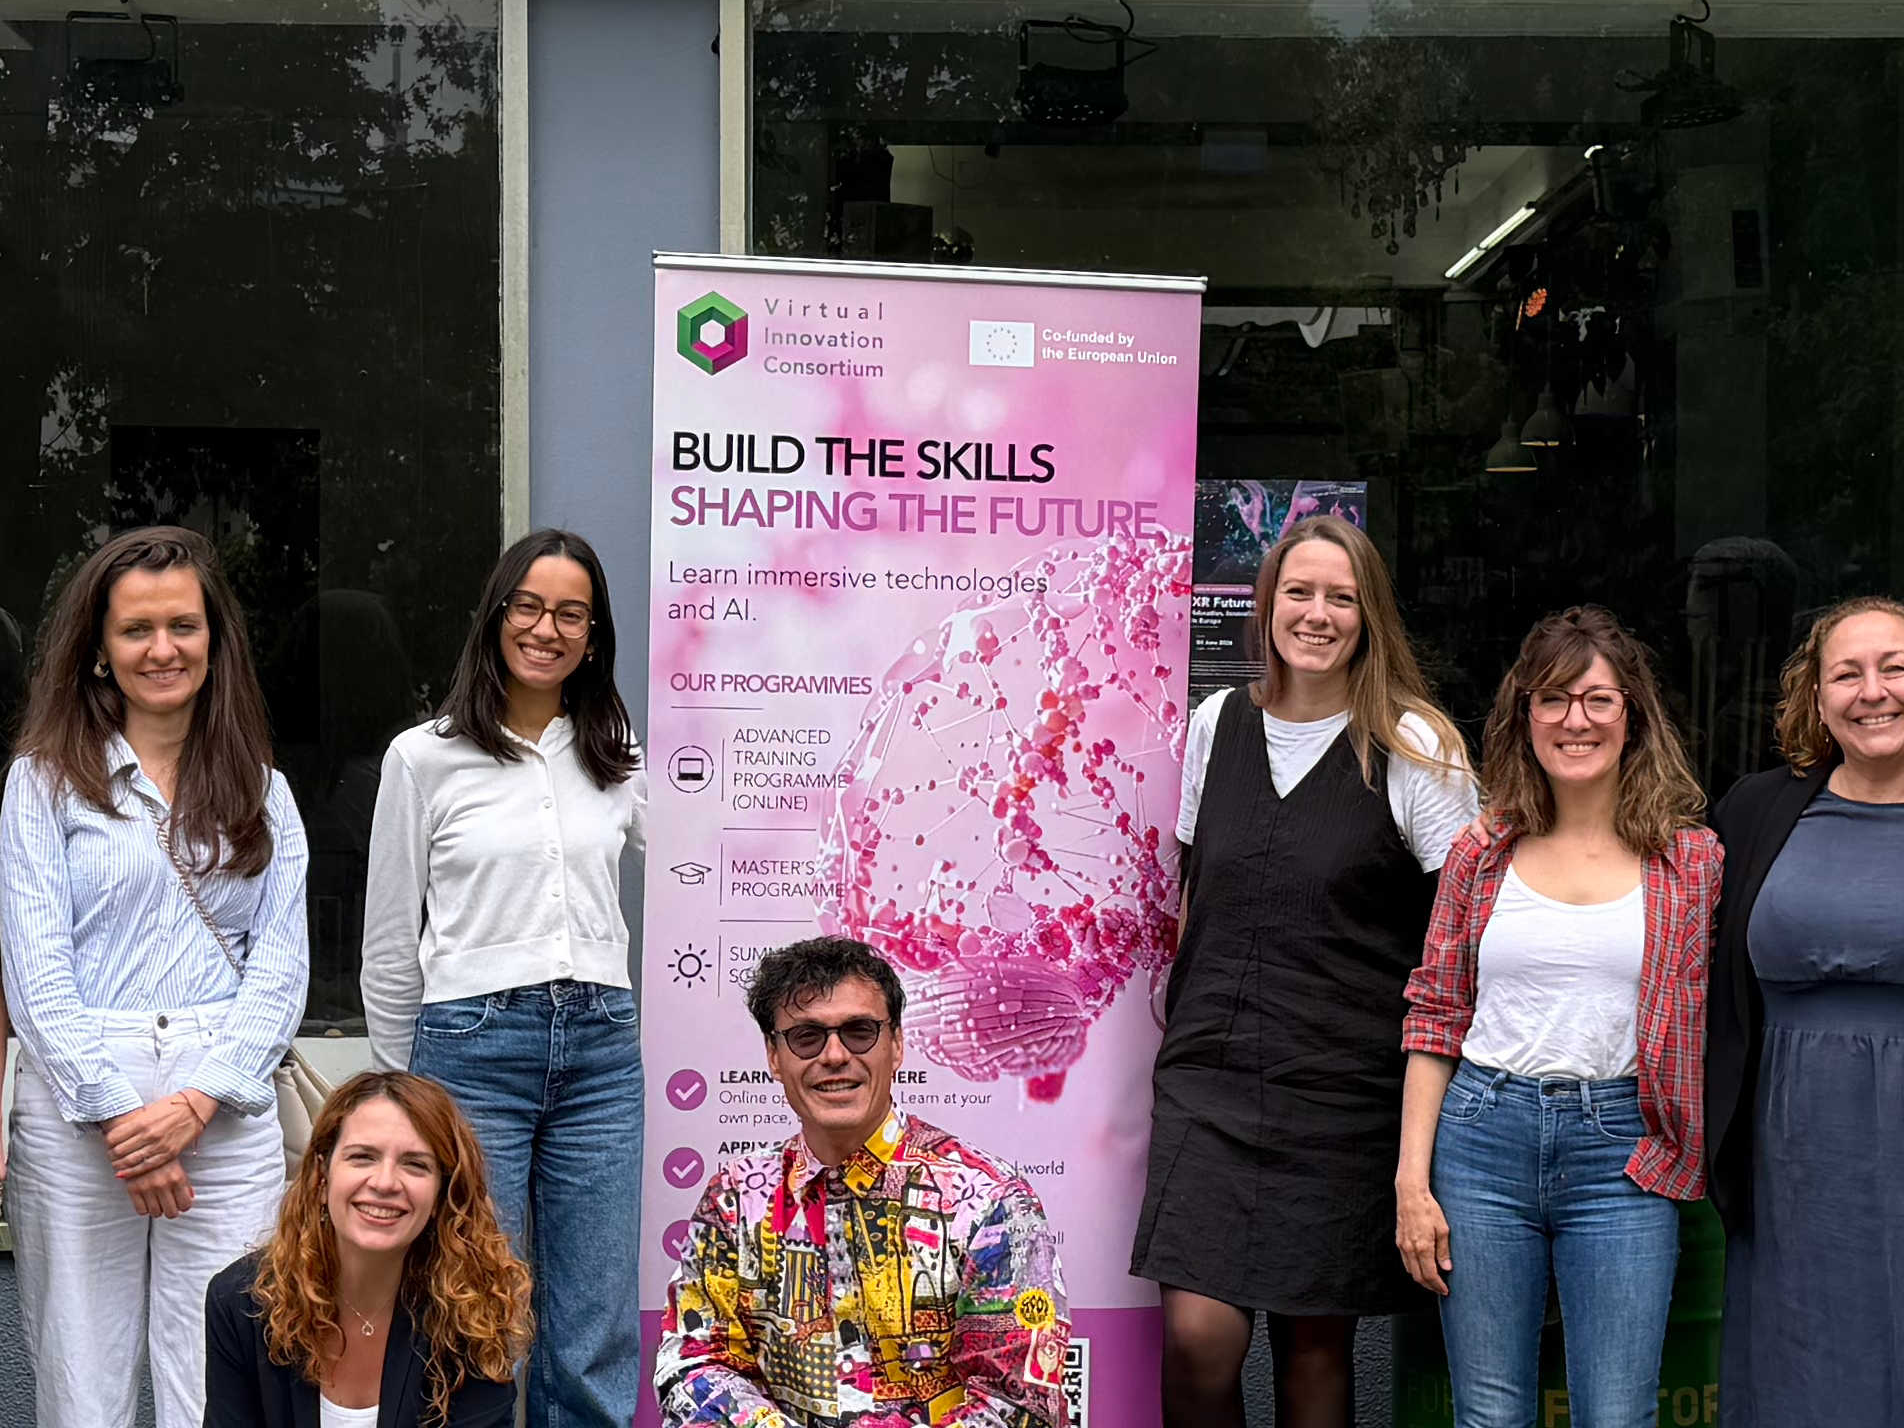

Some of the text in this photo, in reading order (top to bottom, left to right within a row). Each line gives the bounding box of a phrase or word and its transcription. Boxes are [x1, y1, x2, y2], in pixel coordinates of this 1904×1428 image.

[763, 298, 883, 321] Virtual
[763, 327, 884, 349] Innovation
[1041, 328, 1134, 347] Co-funded by
[1041, 347, 1177, 365] the European Union
[763, 355, 884, 378] Consortium
[672, 431, 1056, 484] BUILD THE SKILLS
[669, 485, 1159, 541] SHAPING THE FUTURE
[668, 561, 1050, 600] Learn immersive technologies
[667, 597, 758, 623] and AI.
[1192, 596, 1210, 608] XR
[670, 672, 873, 695] OUR PROGRAMMES
[732, 728, 831, 745] ADVANCED
[733, 750, 817, 767] TRAINING
[733, 772, 847, 789] PROGRAMME
[732, 794, 808, 811] (ONLINE)
[731, 860, 815, 876] MASTER'S
[731, 882, 846, 898] PROGRAMME
[720, 1070, 774, 1084] LEARN
[719, 1090, 767, 1105] Online
[900, 1091, 939, 1105] Learn
[943, 1093, 957, 1105] at
[960, 1093, 992, 1108] your
[718, 1113, 792, 1127] own pace,
[1014, 1161, 1065, 1176] l-world
